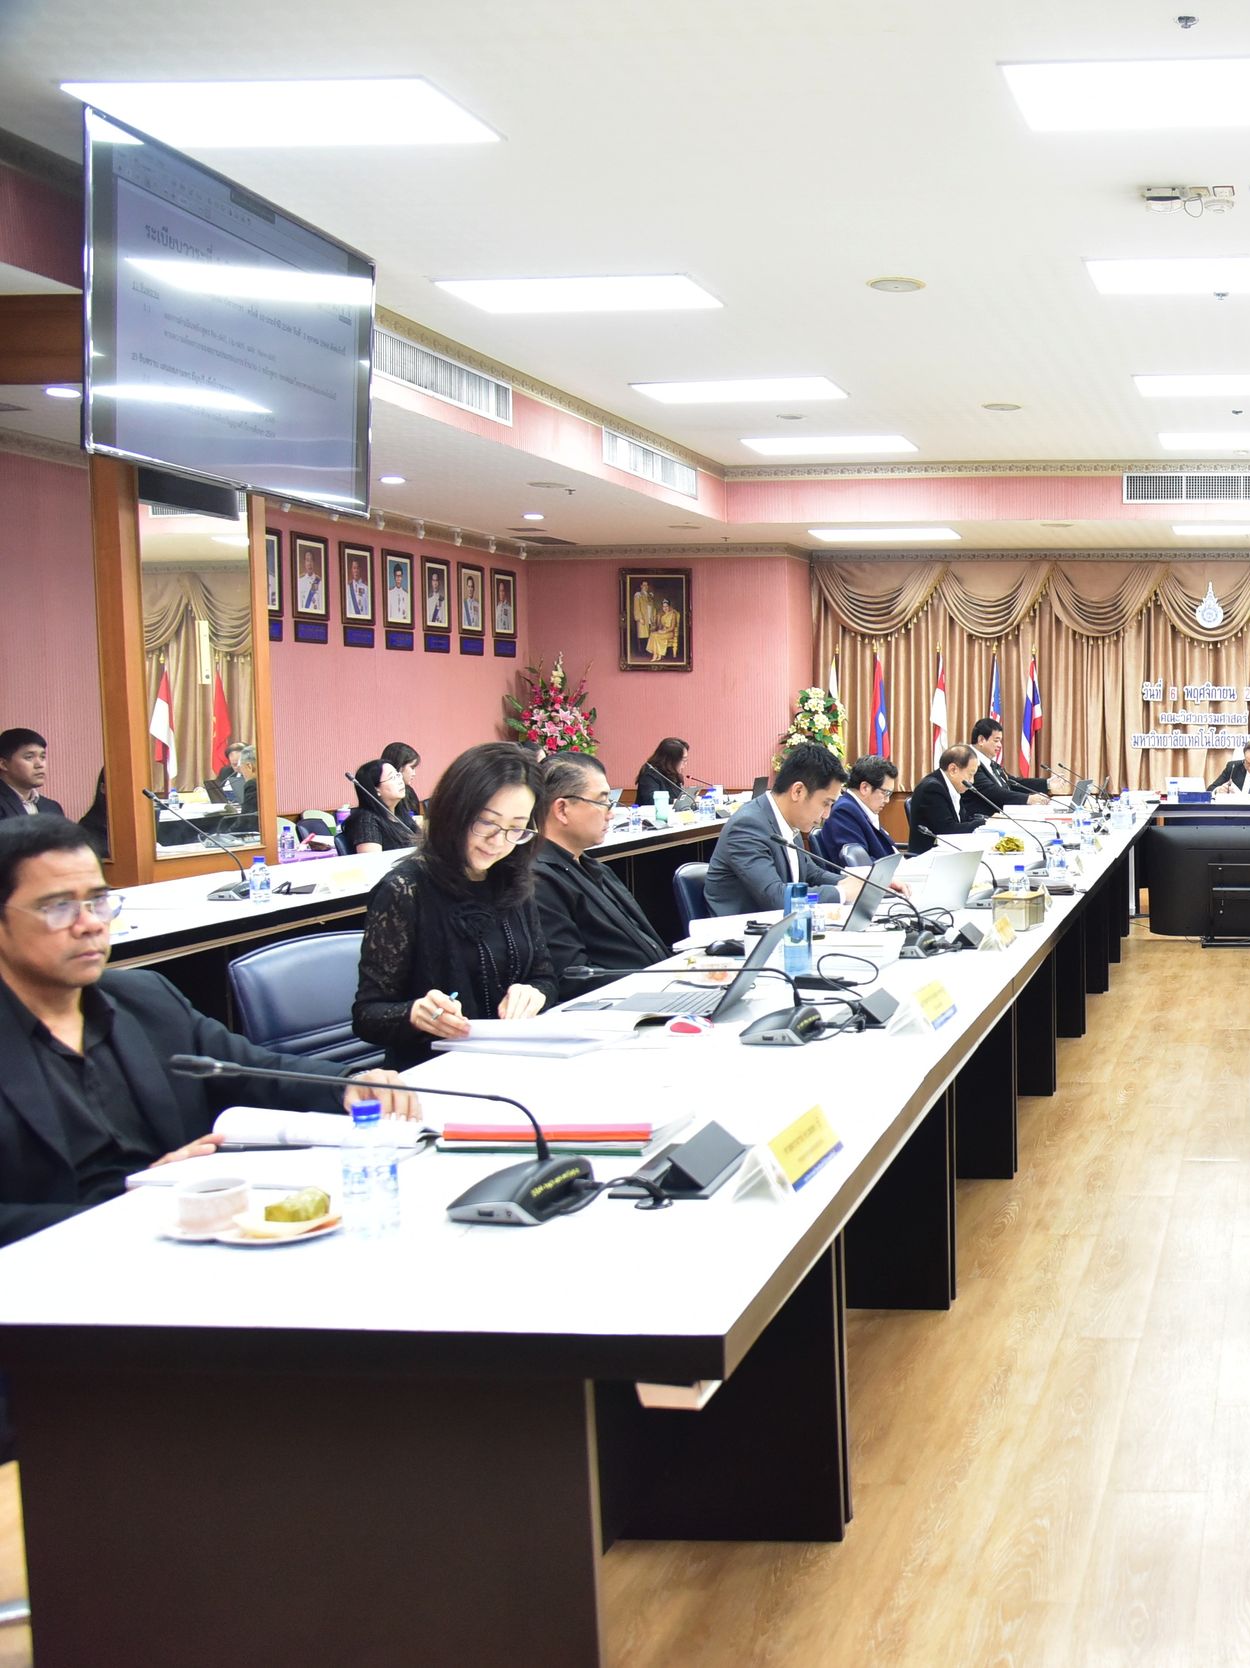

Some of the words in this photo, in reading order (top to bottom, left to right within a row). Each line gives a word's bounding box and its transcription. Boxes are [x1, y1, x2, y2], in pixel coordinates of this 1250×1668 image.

[1143, 680, 1162, 699] วันที่
[1170, 688, 1176, 699] 6
[1185, 683, 1236, 703] พฤศจิกายน
